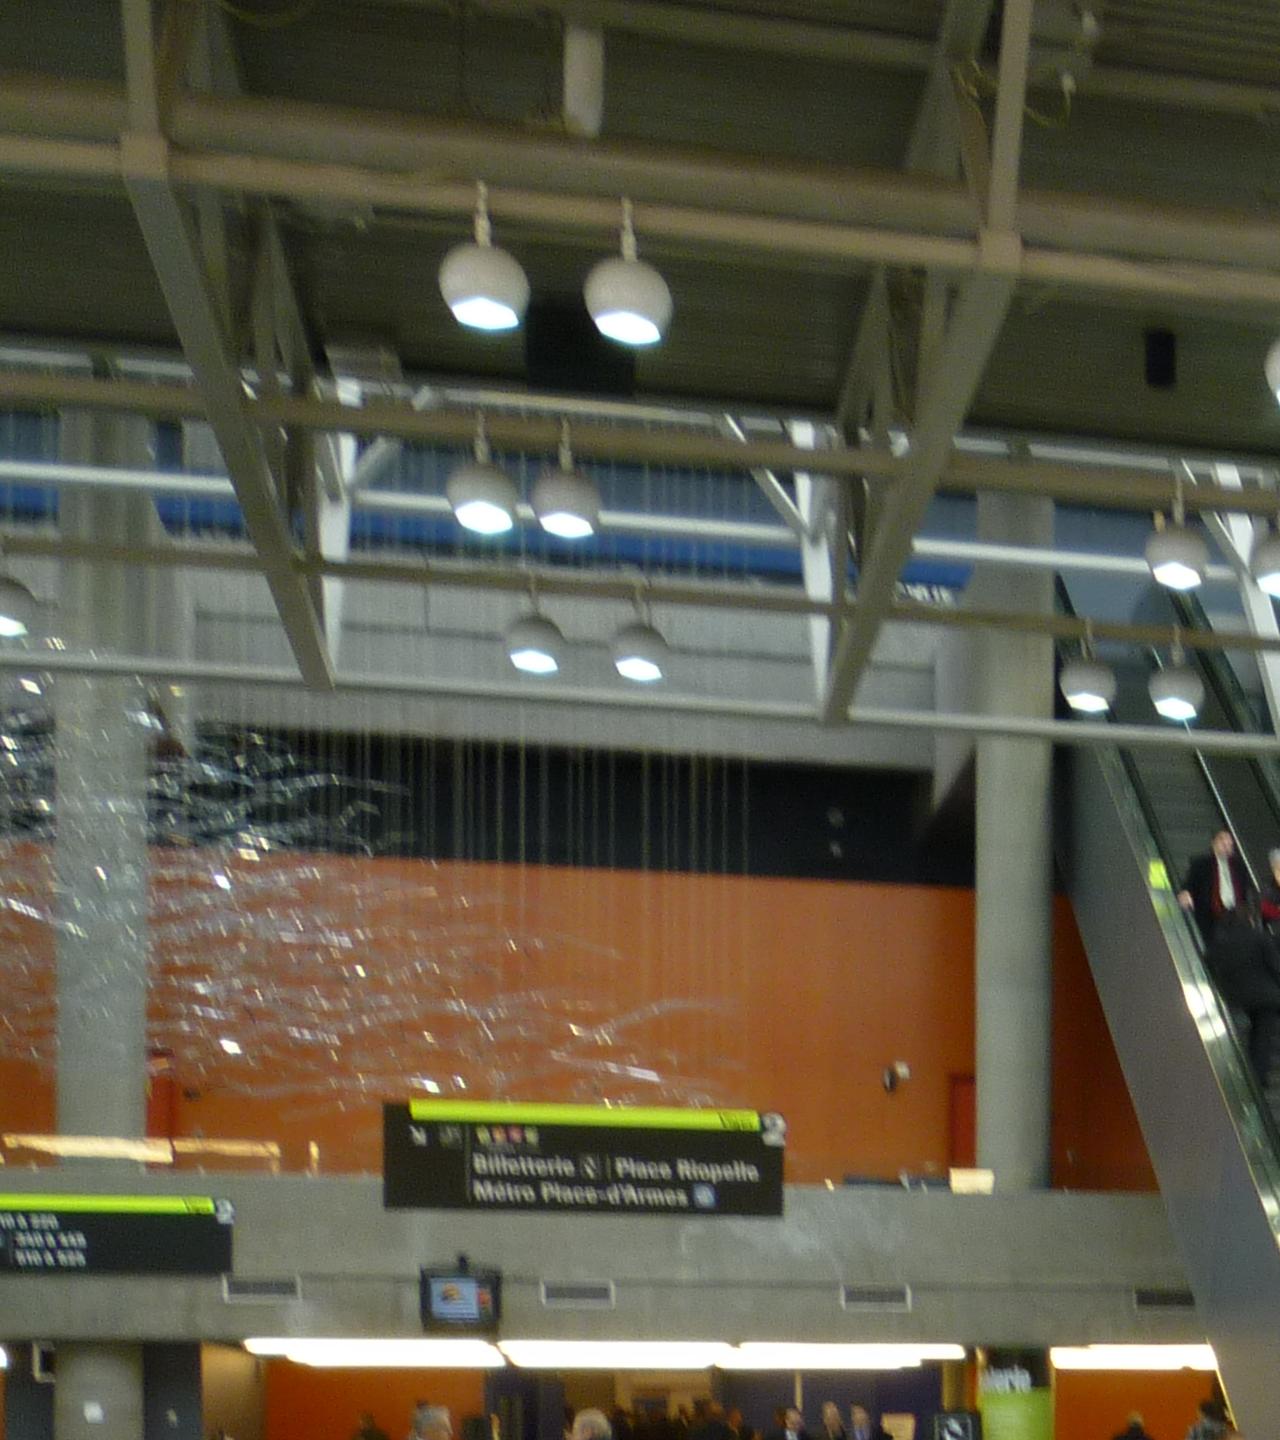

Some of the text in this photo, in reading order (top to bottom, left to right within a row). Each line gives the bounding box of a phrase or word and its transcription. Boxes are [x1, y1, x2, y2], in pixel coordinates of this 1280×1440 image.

[473, 1152, 760, 1184] Billetterie Place Riopelle
[473, 1178, 689, 1207] Métro Place-d'Armes
